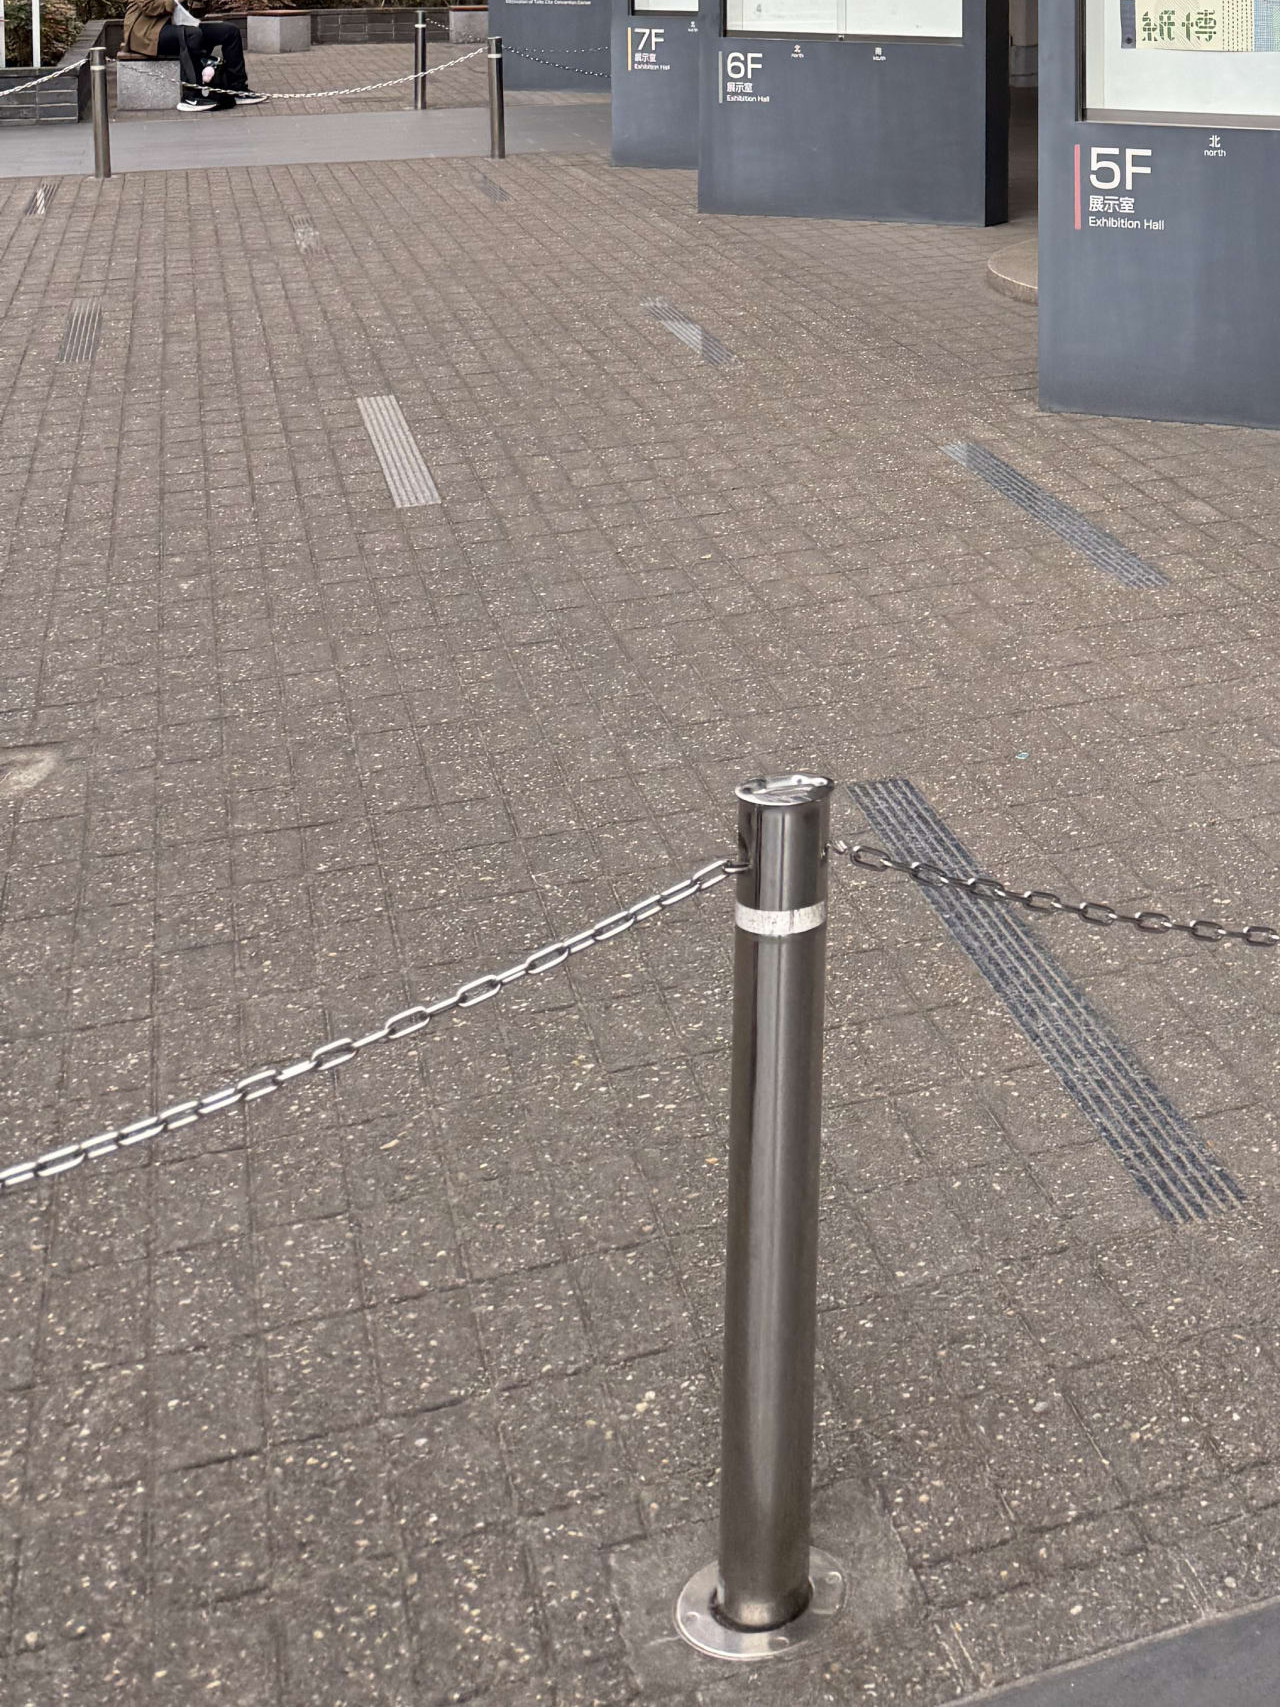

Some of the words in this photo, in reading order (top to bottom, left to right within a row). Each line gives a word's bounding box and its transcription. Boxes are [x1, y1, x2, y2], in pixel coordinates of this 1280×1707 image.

[1142, 9, 1217, 43] 紙博
[633, 27, 665, 51] 7F
[726, 51, 763, 79] 6F
[726, 82, 753, 93] 展示室
[726, 94, 757, 103] Exhibition
[758, 95, 770, 103] Hall
[1208, 134, 1221, 148] 北
[1204, 148, 1226, 158] north
[1088, 146, 1152, 191] 5F
[1088, 195, 1135, 214] 展示室
[1088, 216, 1141, 230] Exhibition
[1144, 218, 1165, 231] Hall
